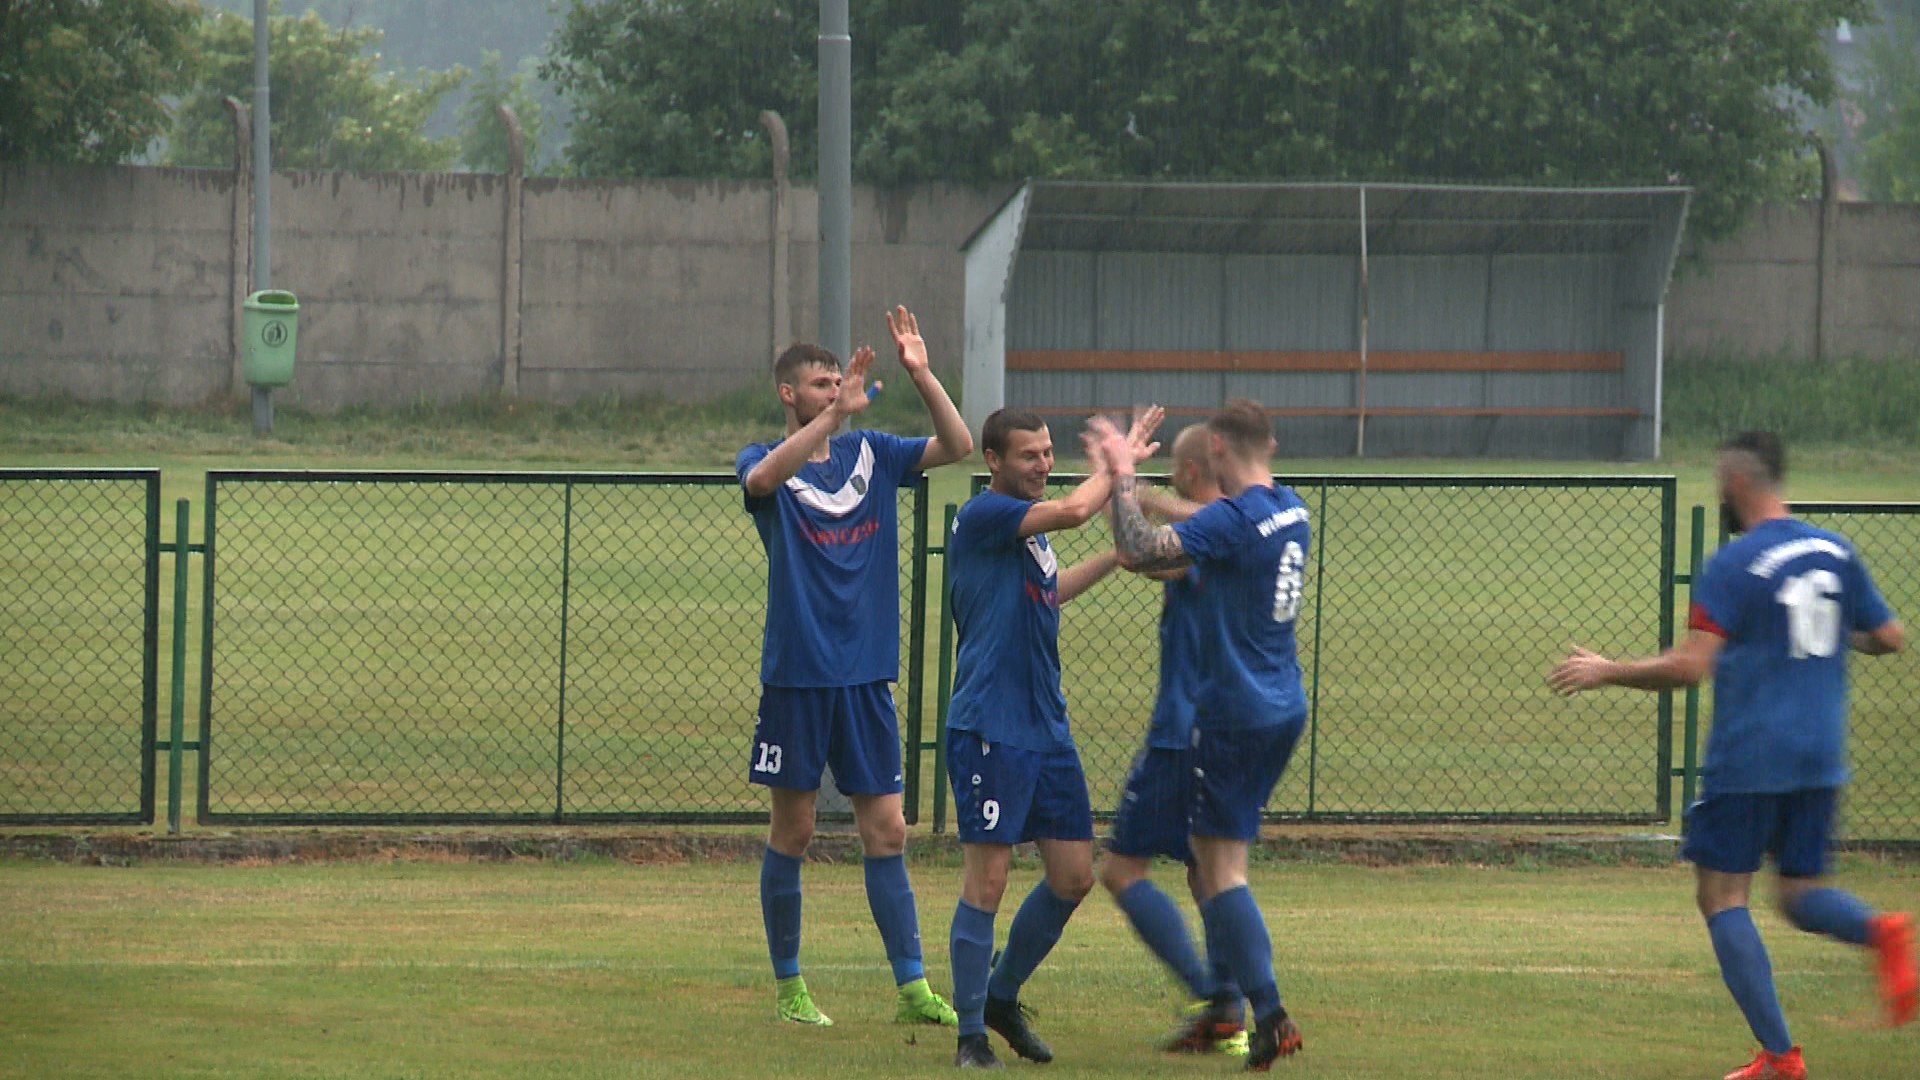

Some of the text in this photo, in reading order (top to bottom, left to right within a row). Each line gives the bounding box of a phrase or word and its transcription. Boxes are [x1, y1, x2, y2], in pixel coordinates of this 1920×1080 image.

[1775, 568, 1842, 659] 16
[754, 742, 782, 774] 13
[983, 799, 1000, 830] 9
